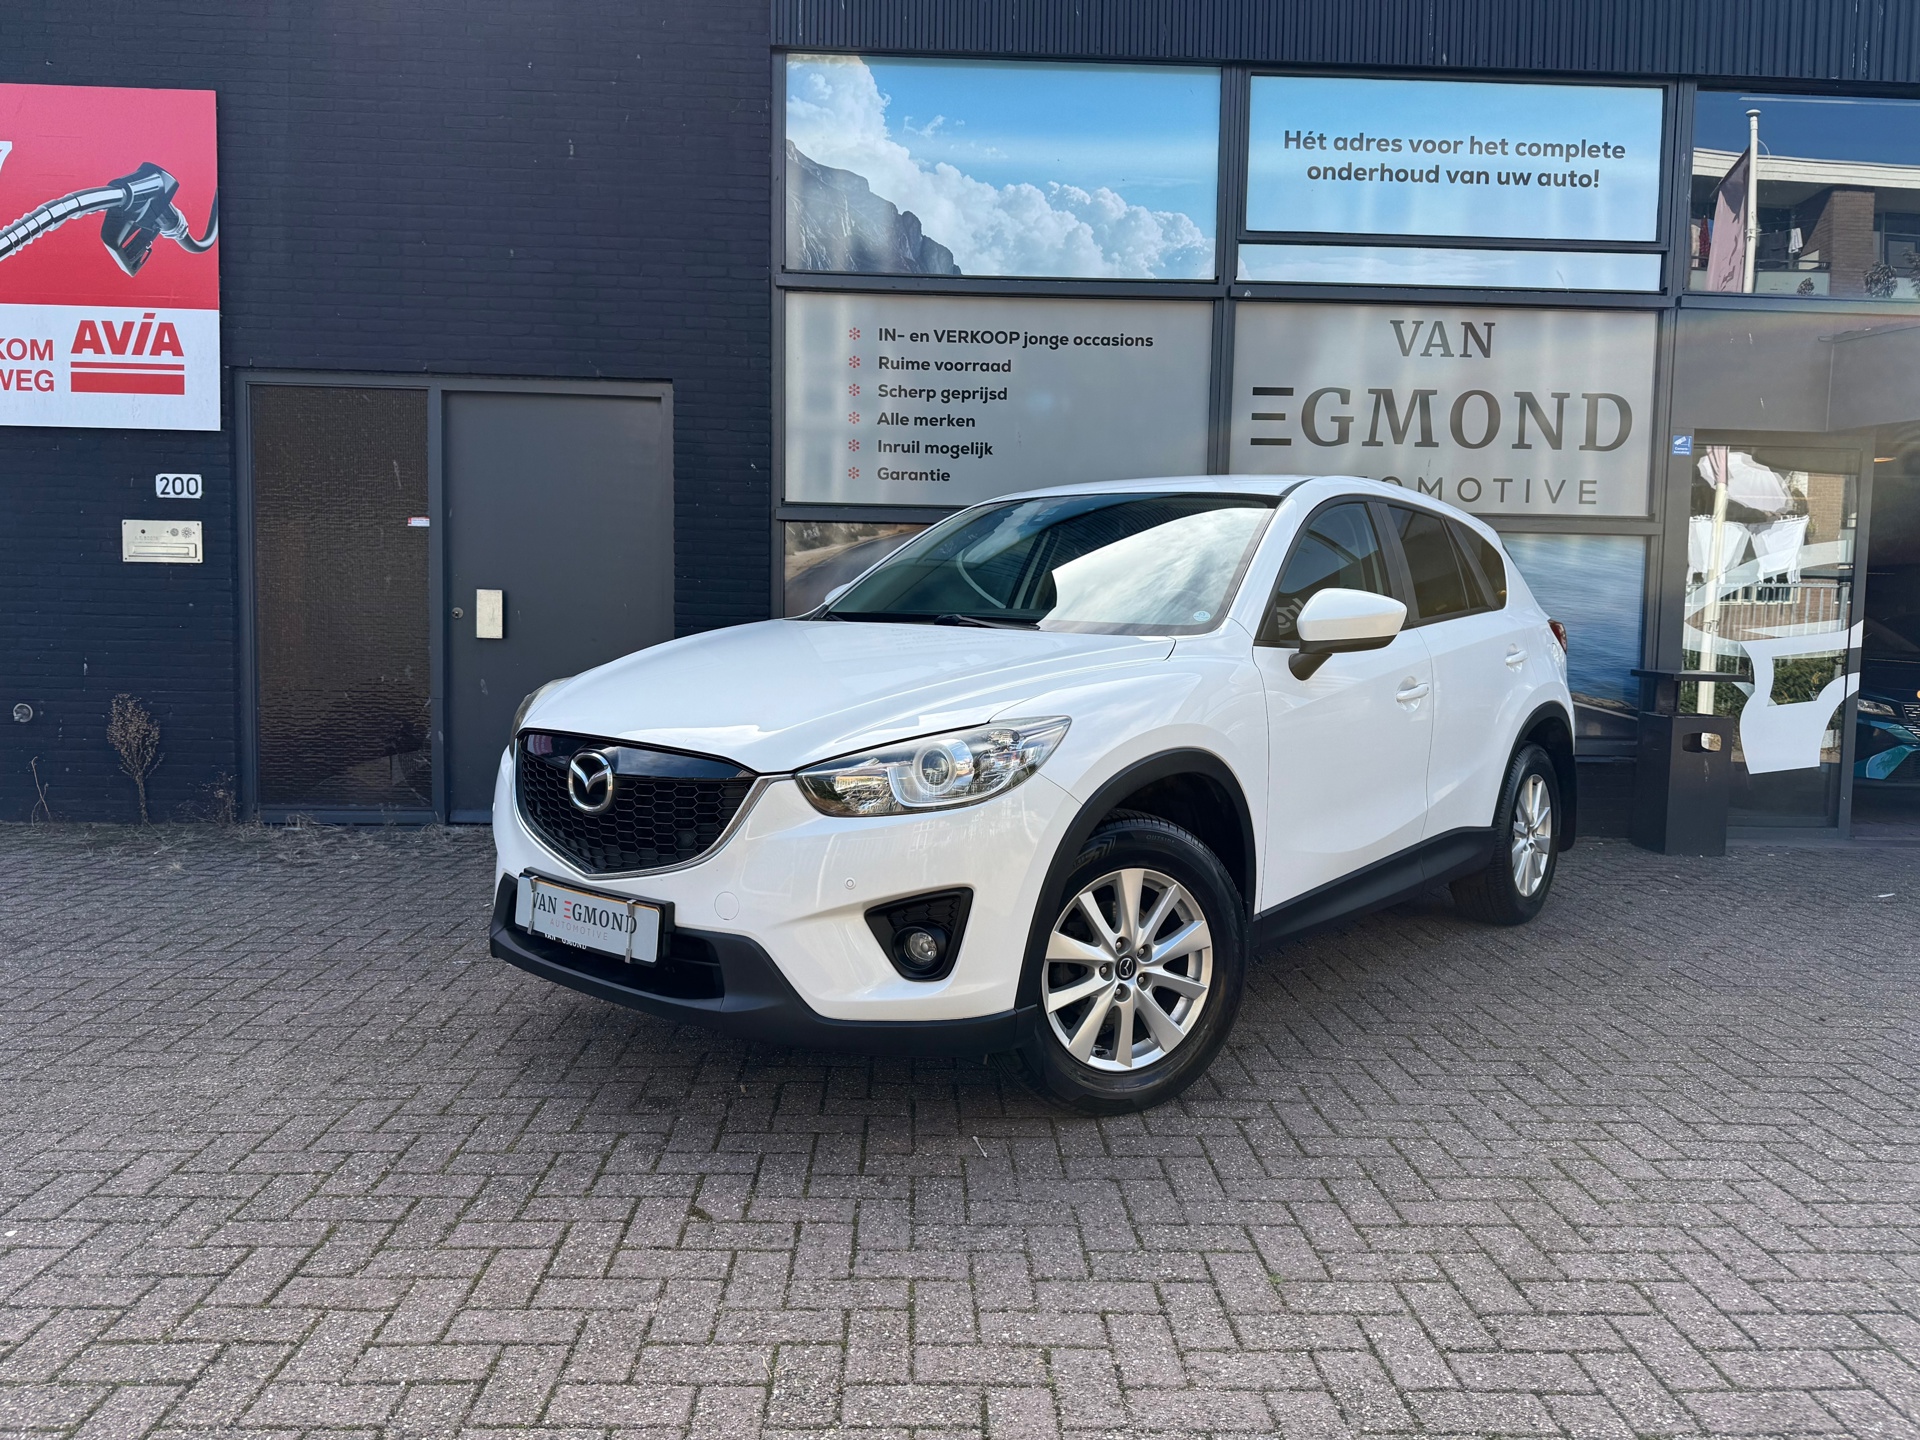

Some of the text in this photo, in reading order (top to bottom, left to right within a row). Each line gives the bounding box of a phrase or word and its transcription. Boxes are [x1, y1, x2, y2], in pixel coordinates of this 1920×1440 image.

[1284, 130, 1626, 162] Hét adres voor het complete
[1306, 161, 1600, 188] onderhoud van uw auto!
[878, 328, 1154, 350] IN- en VERKOOP jonge occasions
[1389, 319, 1496, 359] VAN
[878, 356, 1012, 373] Ruime voorraad
[877, 384, 1008, 403] Scherp geprijsd
[876, 412, 976, 428] Alle merken
[877, 440, 993, 459] Inruil mogelijk
[876, 467, 951, 482] Garantie
[159, 476, 199, 495] 200
[550, 917, 609, 941] AUTOMOTIVE
